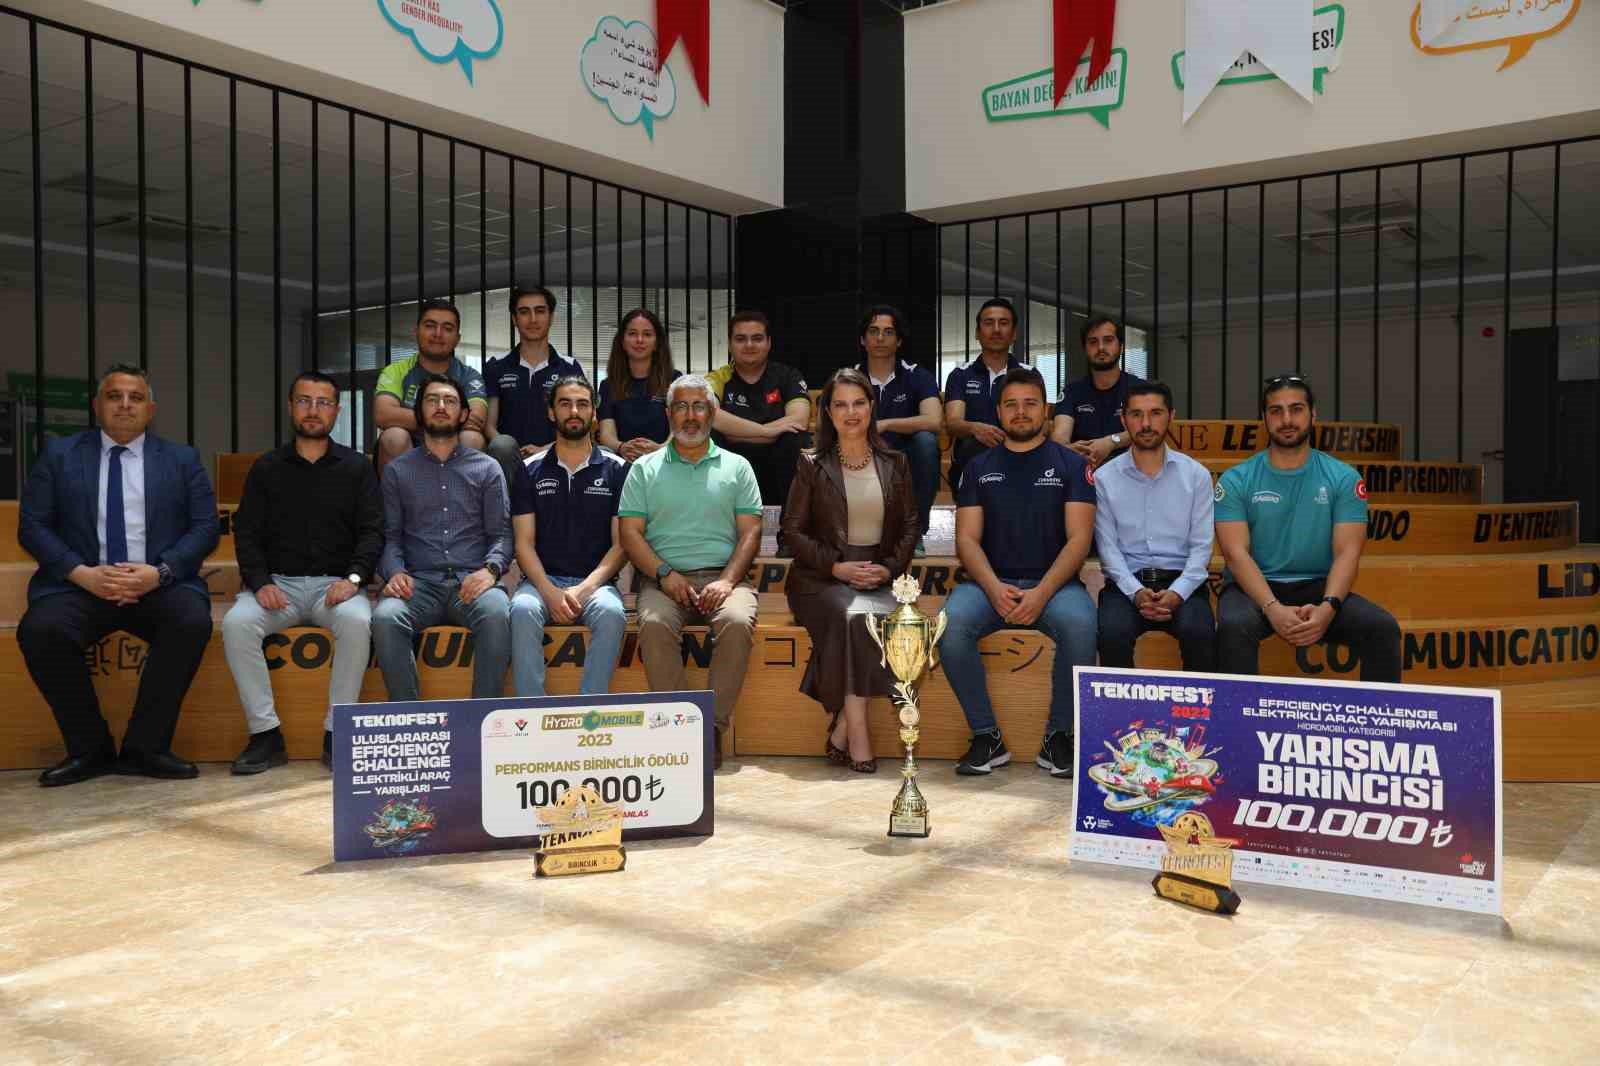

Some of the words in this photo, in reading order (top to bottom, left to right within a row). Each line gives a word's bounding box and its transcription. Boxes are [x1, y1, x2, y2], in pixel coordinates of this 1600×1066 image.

[401, 2, 426, 21] GENDER
[992, 87, 1030, 112] BAYAN
[1090, 681, 1215, 704] TEKNOFEST
[1259, 698, 1343, 714] EFFICIENCY
[1345, 704, 1439, 720] CHALLENGE
[352, 712, 449, 729] TEKNOFEST
[1242, 707, 1322, 722] ELEKTRİKLİ
[1324, 712, 1369, 728] ARAÇ
[1371, 716, 1458, 733] YARIŞMASI
[352, 731, 451, 746] ULUSLARARASI
[577, 733, 613, 748] 2023
[352, 742, 450, 760] EFFICIENCY
[352, 755, 451, 773] CHALLENGE
[495, 757, 581, 776] PERFORMANS
[583, 754, 646, 772] BİRİNCİLİK
[647, 752, 689, 768] ÖDÜLÜ
[352, 771, 419, 785] ELEKTRİKLİ
[420, 771, 451, 783] ARAÇ
[375, 784, 431, 797] YARIŞLARI
